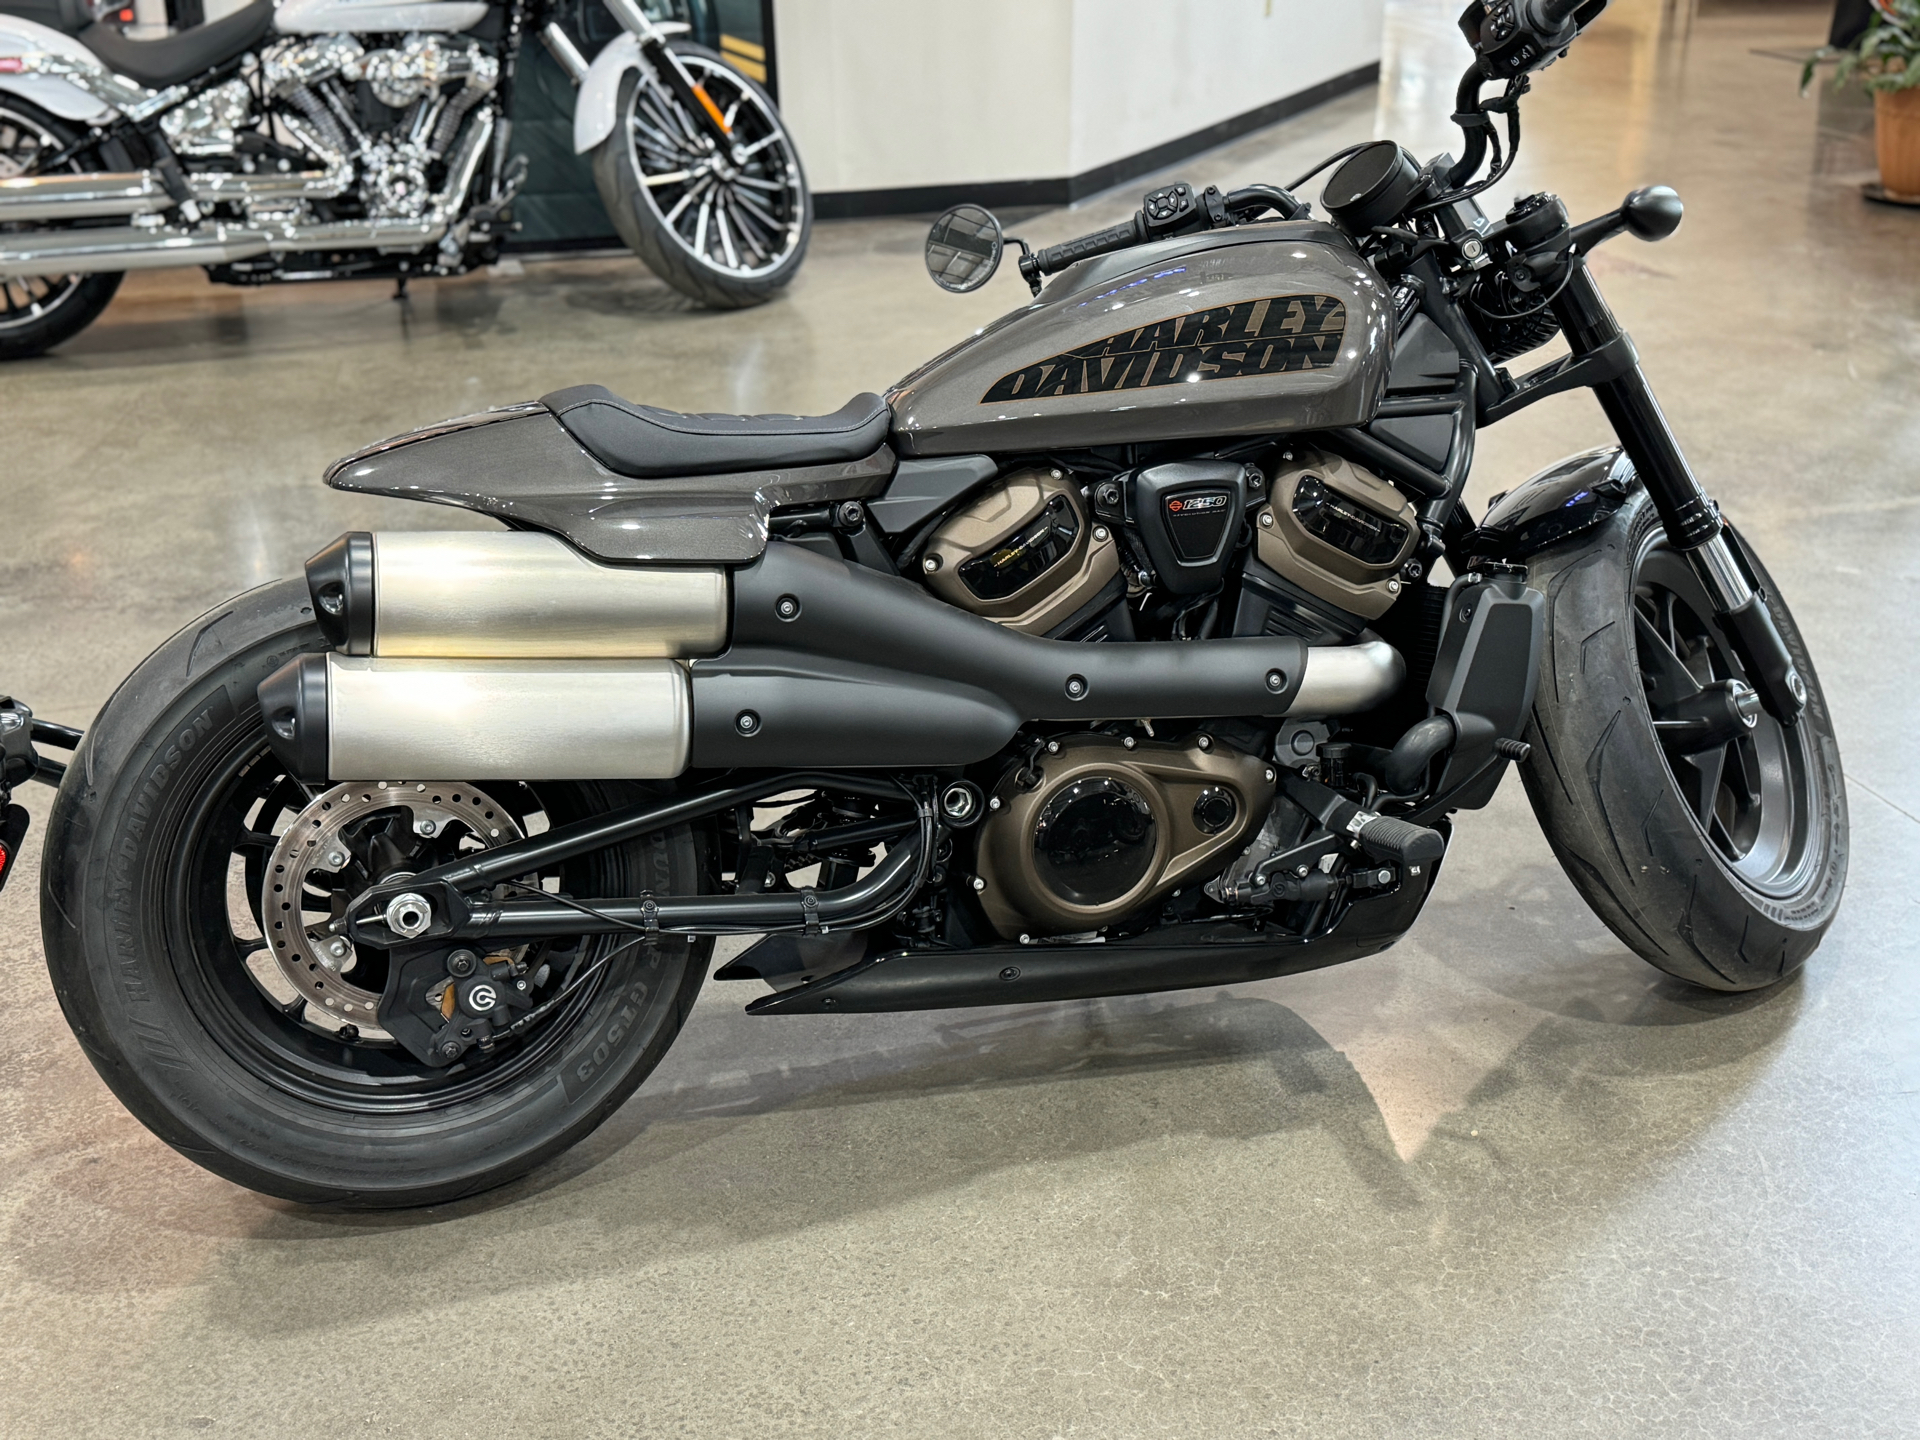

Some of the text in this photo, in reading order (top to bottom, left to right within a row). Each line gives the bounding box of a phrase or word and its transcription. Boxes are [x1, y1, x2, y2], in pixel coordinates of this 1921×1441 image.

[1066, 294, 1346, 358] HARLEY
[981, 332, 1344, 404] DAVIDSON
[1183, 496, 1227, 510] 1250
[107, 708, 214, 1002] HARLEY-DAVIDSON
[576, 981, 649, 1084] GT503
